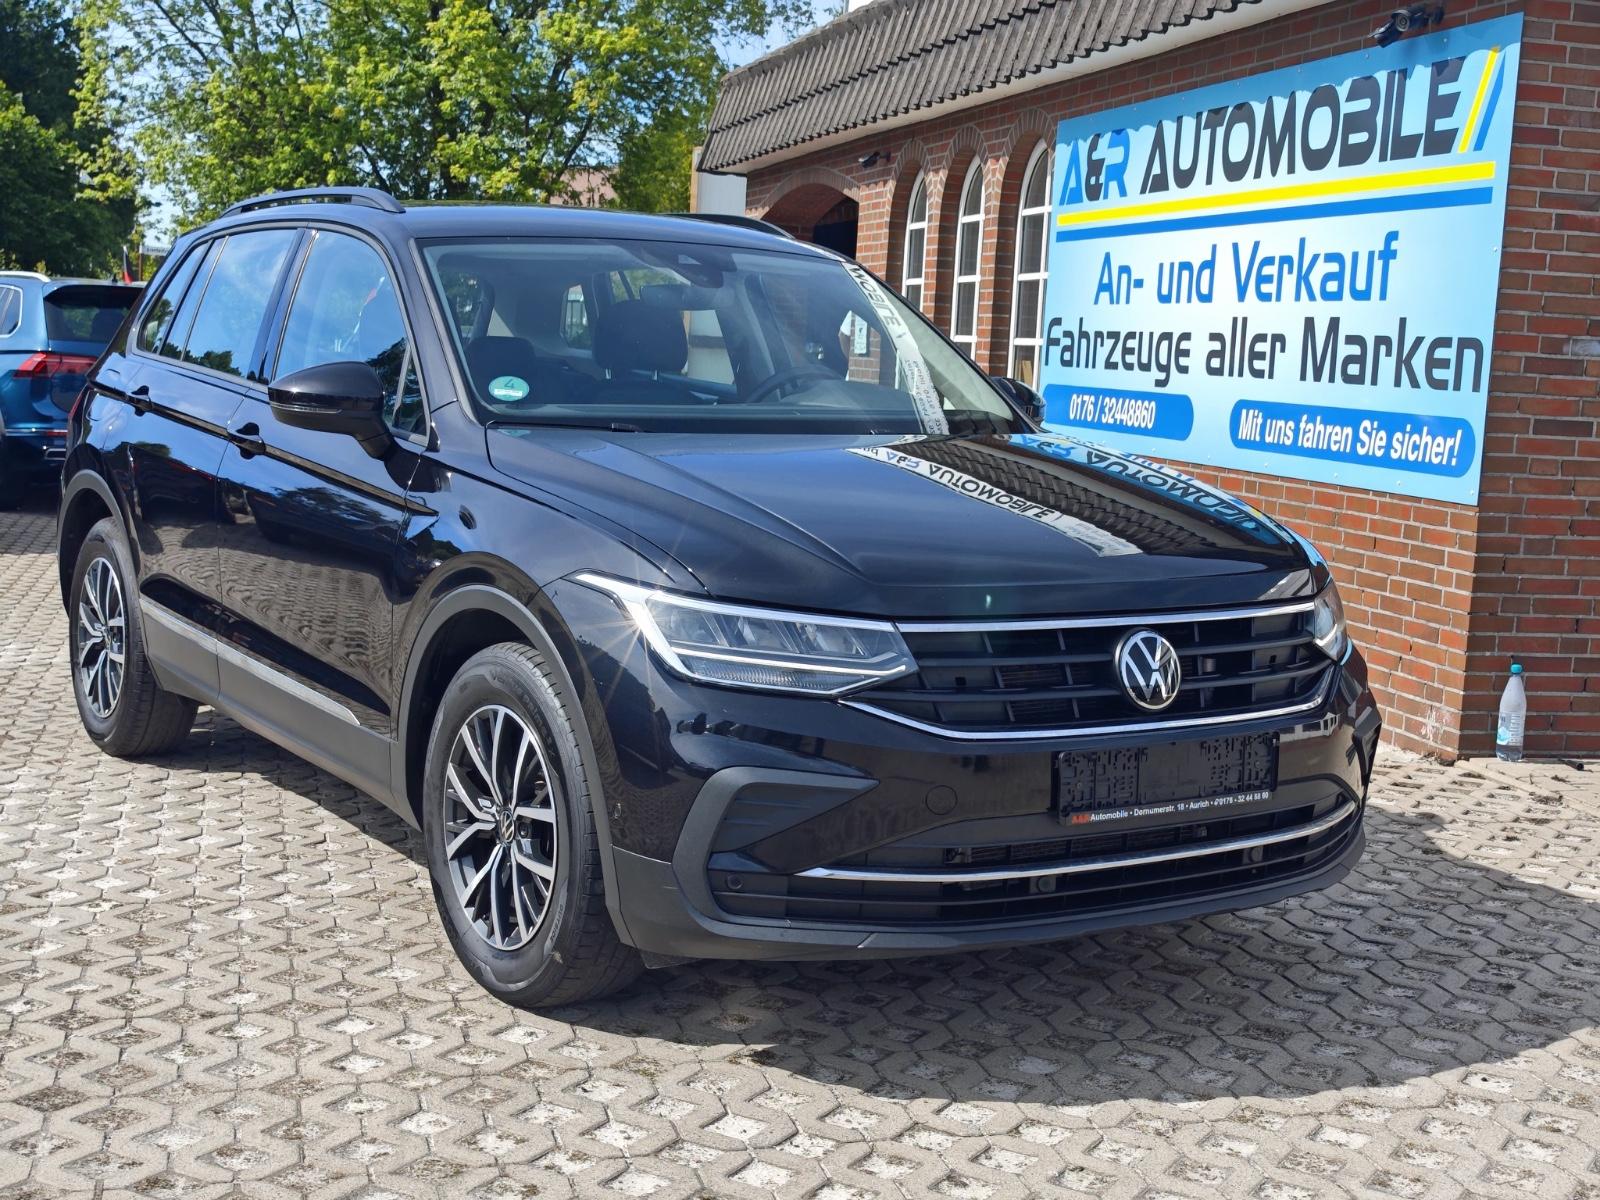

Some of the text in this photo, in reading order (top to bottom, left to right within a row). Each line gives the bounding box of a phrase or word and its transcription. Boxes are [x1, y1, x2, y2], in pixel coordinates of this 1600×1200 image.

[1059, 56, 1468, 206] A&R AUTOMOBILE
[1093, 230, 1399, 305] An- und Verkauf
[1044, 316, 1485, 393] Fahrzeuge aller Marken
[1069, 393, 1096, 422] 0176
[1102, 396, 1156, 430] 32448860
[1238, 408, 1463, 466] Mit uns fahren Sie sicher!
[1090, 809, 1128, 822] Automobile
[1189, 800, 1210, 810] Aurich
